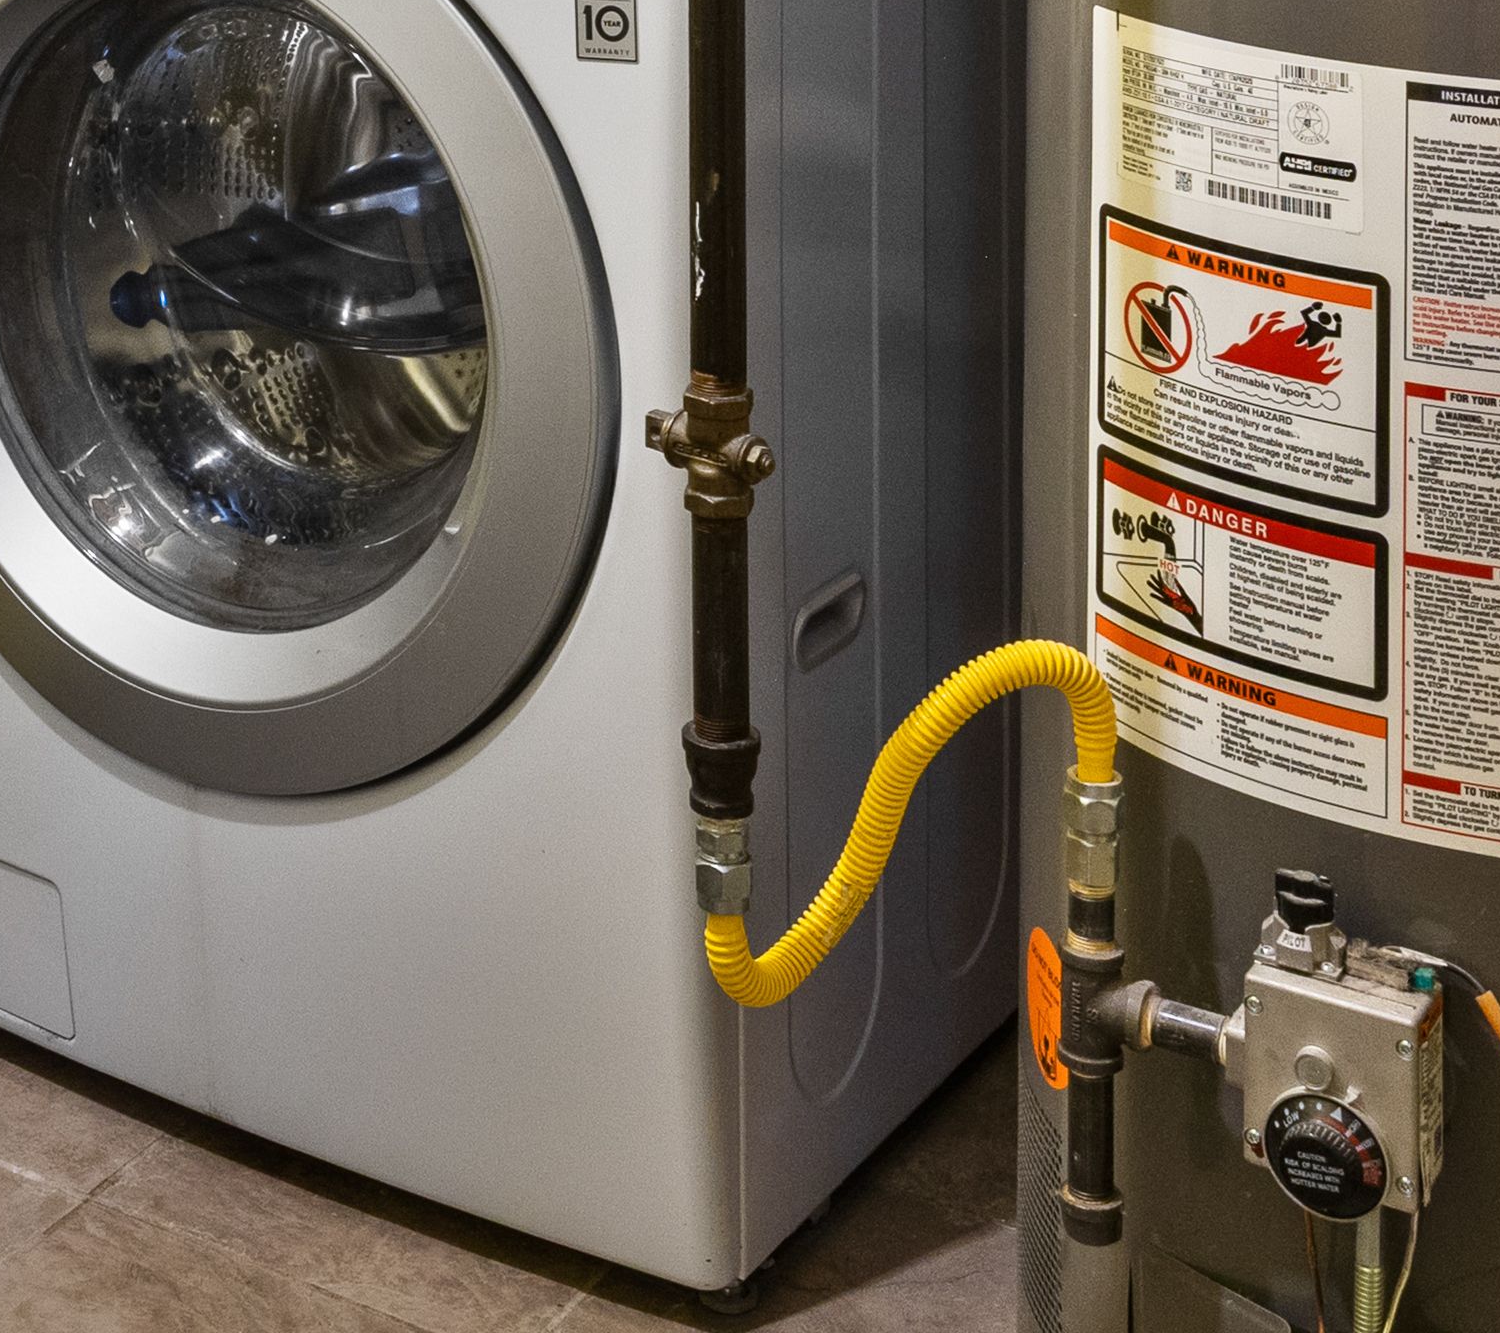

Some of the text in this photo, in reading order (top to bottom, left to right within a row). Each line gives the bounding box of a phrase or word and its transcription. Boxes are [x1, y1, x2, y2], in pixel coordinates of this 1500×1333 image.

[583, 5, 629, 42] 10
[1187, 250, 1286, 288] WARNING
[1215, 367, 1311, 401] Flammable Vapors
[1450, 393, 1469, 404] FOR
[1471, 395, 1497, 408] YOUR
[1159, 379, 1293, 425] FIRE AND EXPLOSION HAZARD
[1186, 499, 1268, 538] DANGER
[1160, 560, 1180, 575] HOT
[1187, 665, 1276, 706] WARNING
[1464, 786, 1476, 797] TO
[1282, 933, 1306, 949] PILOT
[1284, 1111, 1300, 1128] LOW
